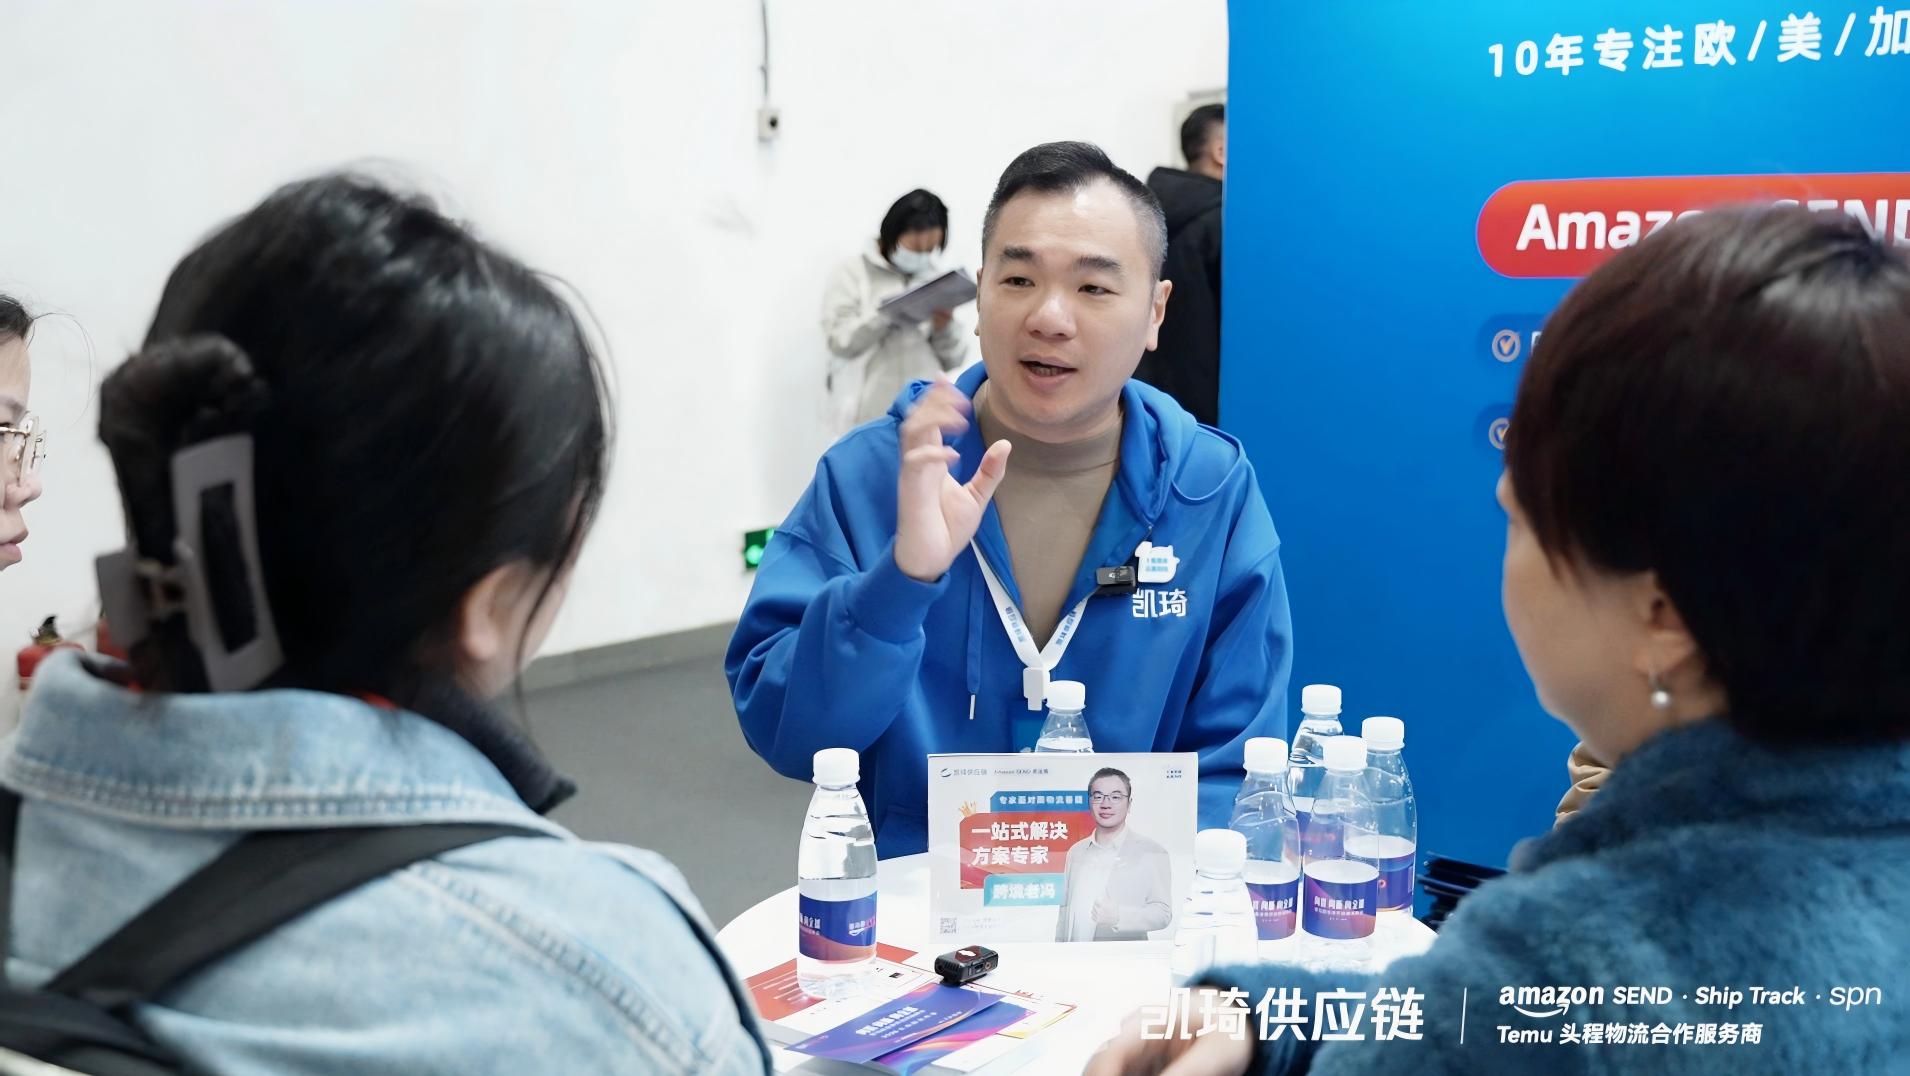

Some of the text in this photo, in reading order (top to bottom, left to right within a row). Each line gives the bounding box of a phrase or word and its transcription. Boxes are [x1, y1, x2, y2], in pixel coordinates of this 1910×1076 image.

[1515, 203, 1704, 252] Amaz
[1132, 588, 1187, 618] 凯琦
[971, 821, 1068, 841] 一站式解决
[971, 845, 1049, 866] 方案专家
